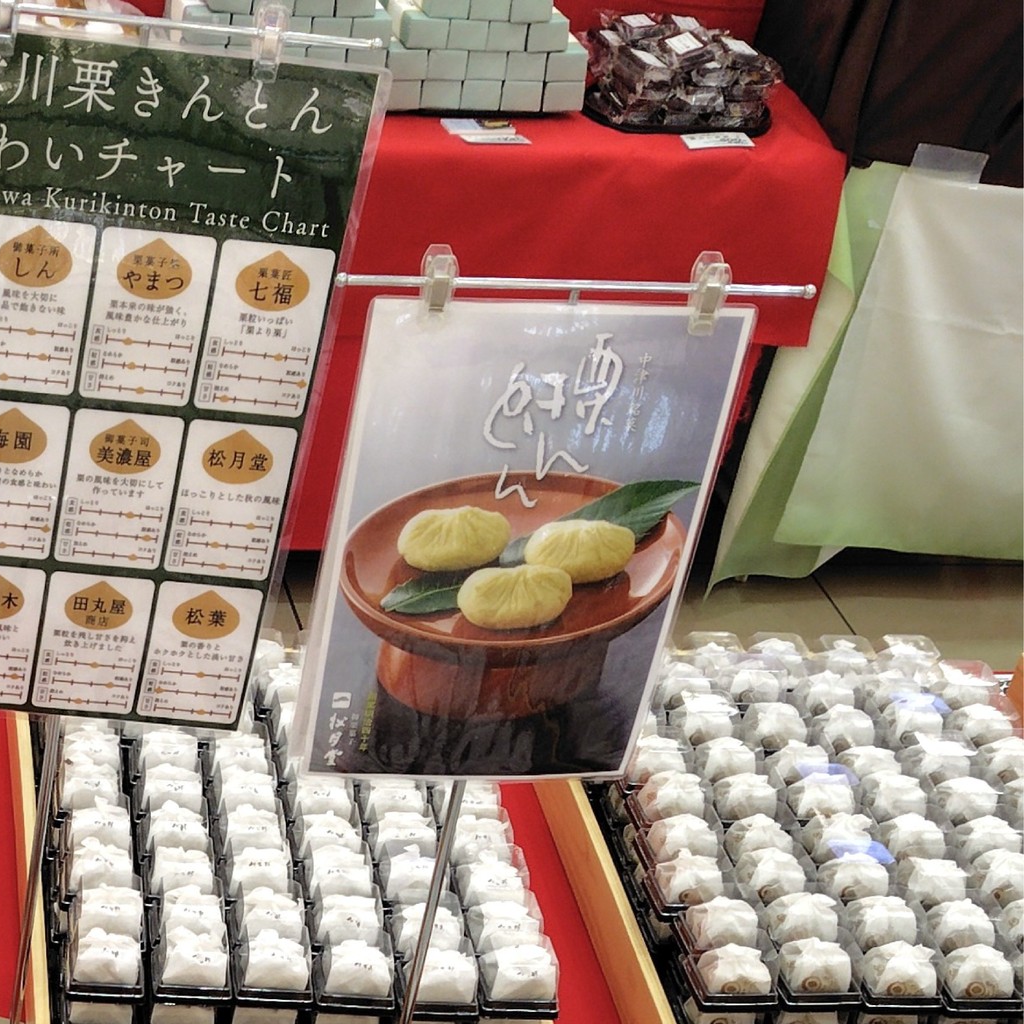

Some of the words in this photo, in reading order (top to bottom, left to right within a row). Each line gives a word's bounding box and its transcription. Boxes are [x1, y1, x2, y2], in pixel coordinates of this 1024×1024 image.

[44, 185, 178, 223] Kurikinton
[189, 202, 252, 230] Taste
[261, 210, 332, 239] Chart
[14, 257, 56, 279] しん
[123, 270, 184, 291] やまつ
[2, 288, 57, 303] 風味を大切に
[249, 281, 294, 305] 七福
[105, 311, 187, 328] 風味豊かな仕上がり
[239, 312, 293, 326] 栗粒いっぱい
[104, 433, 151, 447] 御菓子司
[96, 446, 152, 467] 美濃屋
[207, 449, 268, 472] 松月堂
[77, 473, 164, 490] 栗の風味を大切にして
[92, 486, 144, 499] 作っています
[181, 488, 281, 505] ほっこりとした秋の風味
[73, 595, 127, 615] 田丸屋
[85, 615, 110, 628] 商店
[185, 607, 227, 628] 松葉
[180, 640, 221, 652] 栗の香りと
